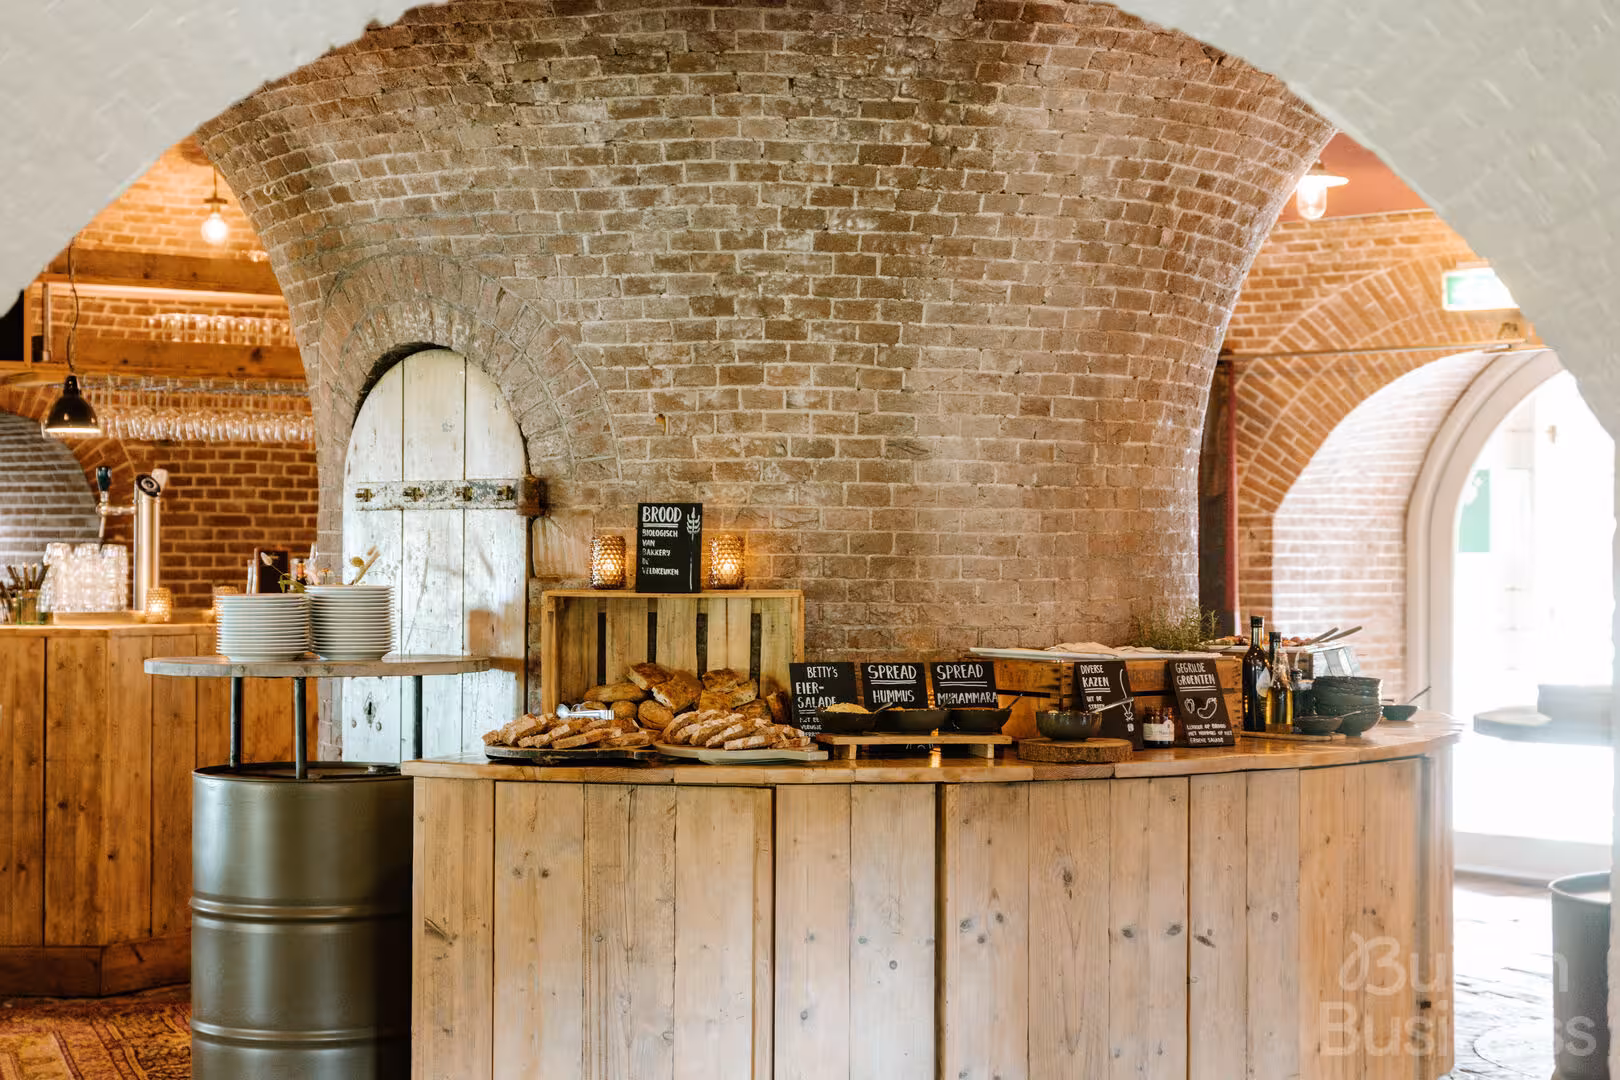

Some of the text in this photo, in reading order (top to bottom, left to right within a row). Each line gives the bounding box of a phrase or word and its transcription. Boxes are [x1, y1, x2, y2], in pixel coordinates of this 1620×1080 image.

[642, 506, 682, 523] BROOD
[642, 529, 678, 537] BIOLOGISCH
[868, 665, 916, 679] SPREAD
[937, 664, 984, 680] SPREAD
[1080, 665, 1104, 674] DIVERSE
[1082, 677, 1110, 687] KAZEN
[1176, 674, 1216, 685] GROENTEN
[796, 682, 824, 695] EIER-
[798, 696, 836, 708] SALADE
[872, 690, 915, 703] HUMMUS
